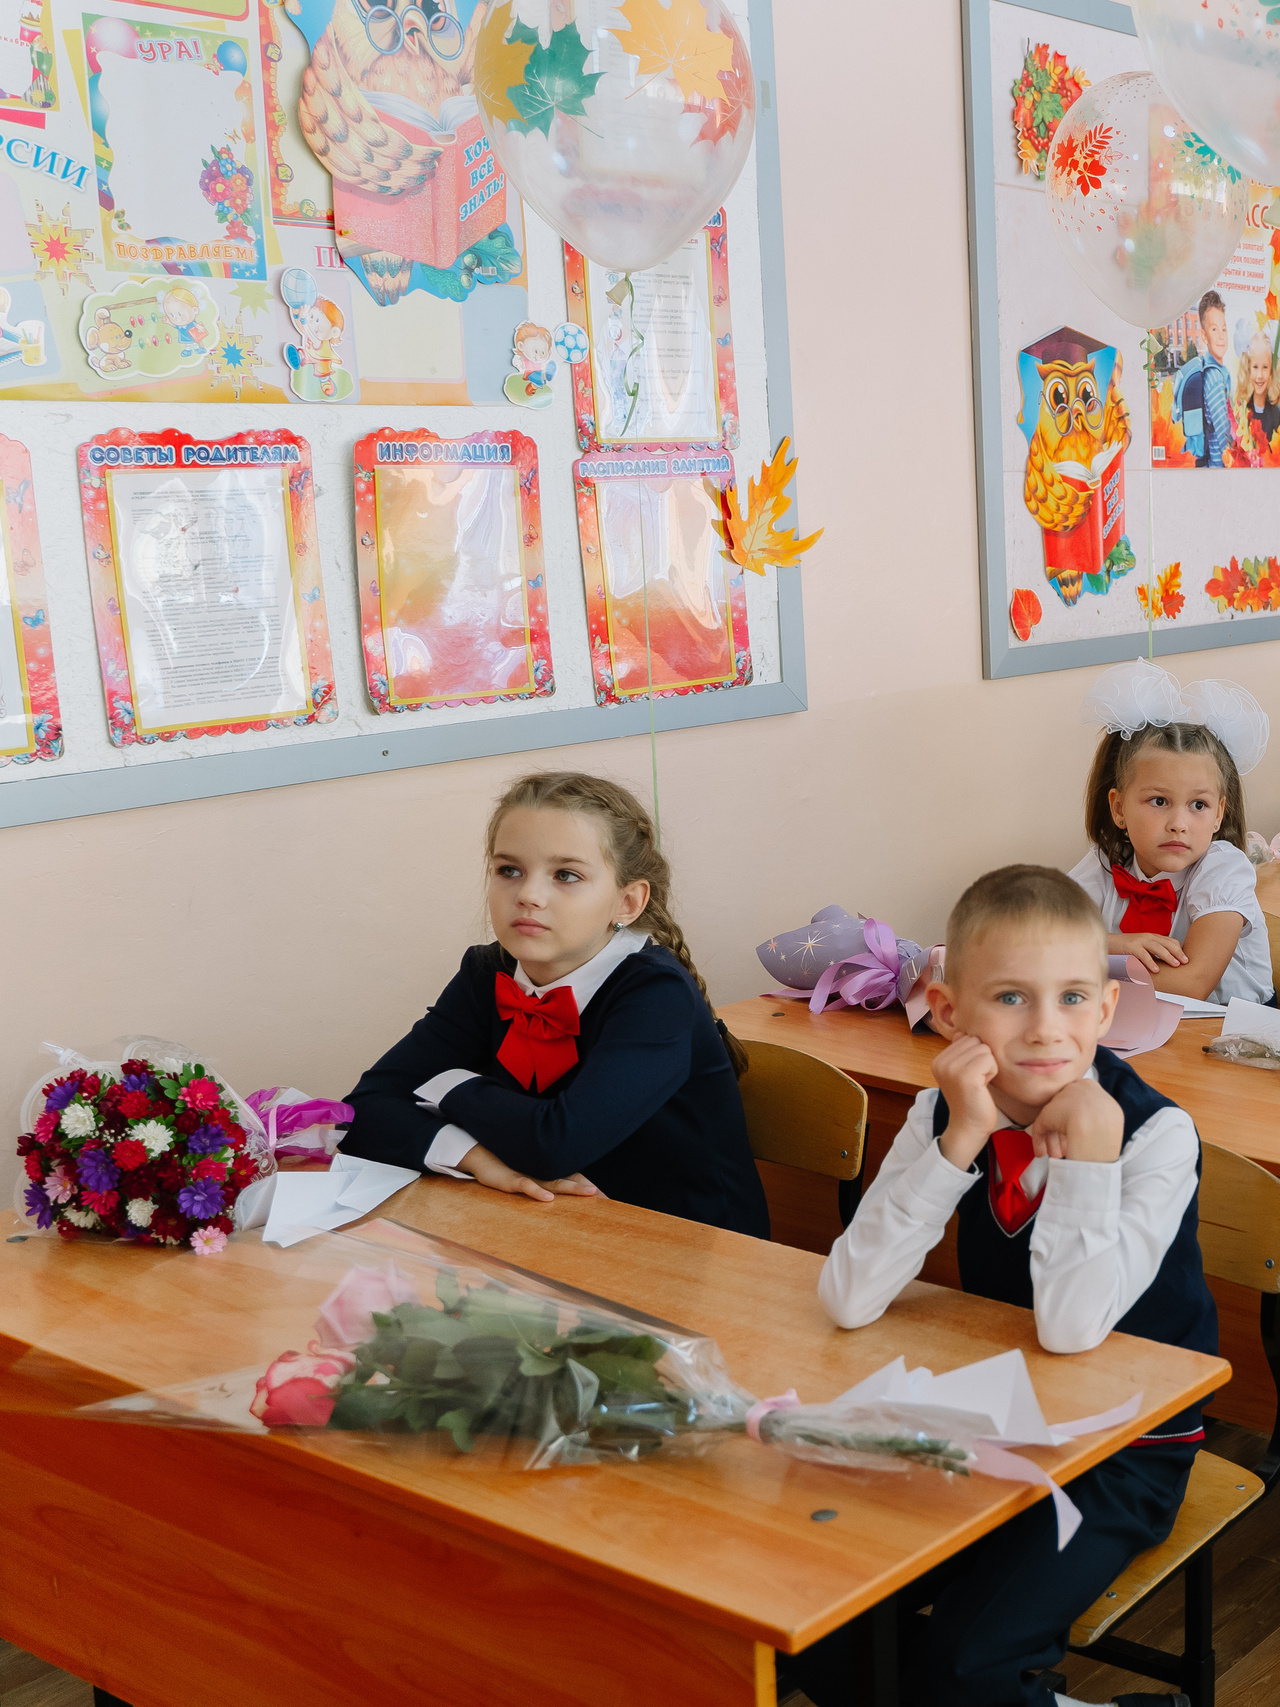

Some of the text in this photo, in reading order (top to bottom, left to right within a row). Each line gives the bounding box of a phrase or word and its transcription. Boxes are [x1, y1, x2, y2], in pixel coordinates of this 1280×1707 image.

[138, 40, 201, 62] УРА!
[0, 133, 90, 190] СИИ
[464, 136, 490, 167] ХОЧ
[471, 154, 494, 188] ВСЁ
[460, 173, 504, 221] ЗНАТЬ!
[115, 242, 255, 262] ПОЗДРАВЛЯЕМ!
[89, 446, 299, 464] СОВЕТЫ РОДИТЕЛЯМ
[378, 443, 511, 462] ИНФОРМАЦИЯ
[580, 455, 730, 477] РАСПИСАНИЕ ЗАНЯТИЙ
